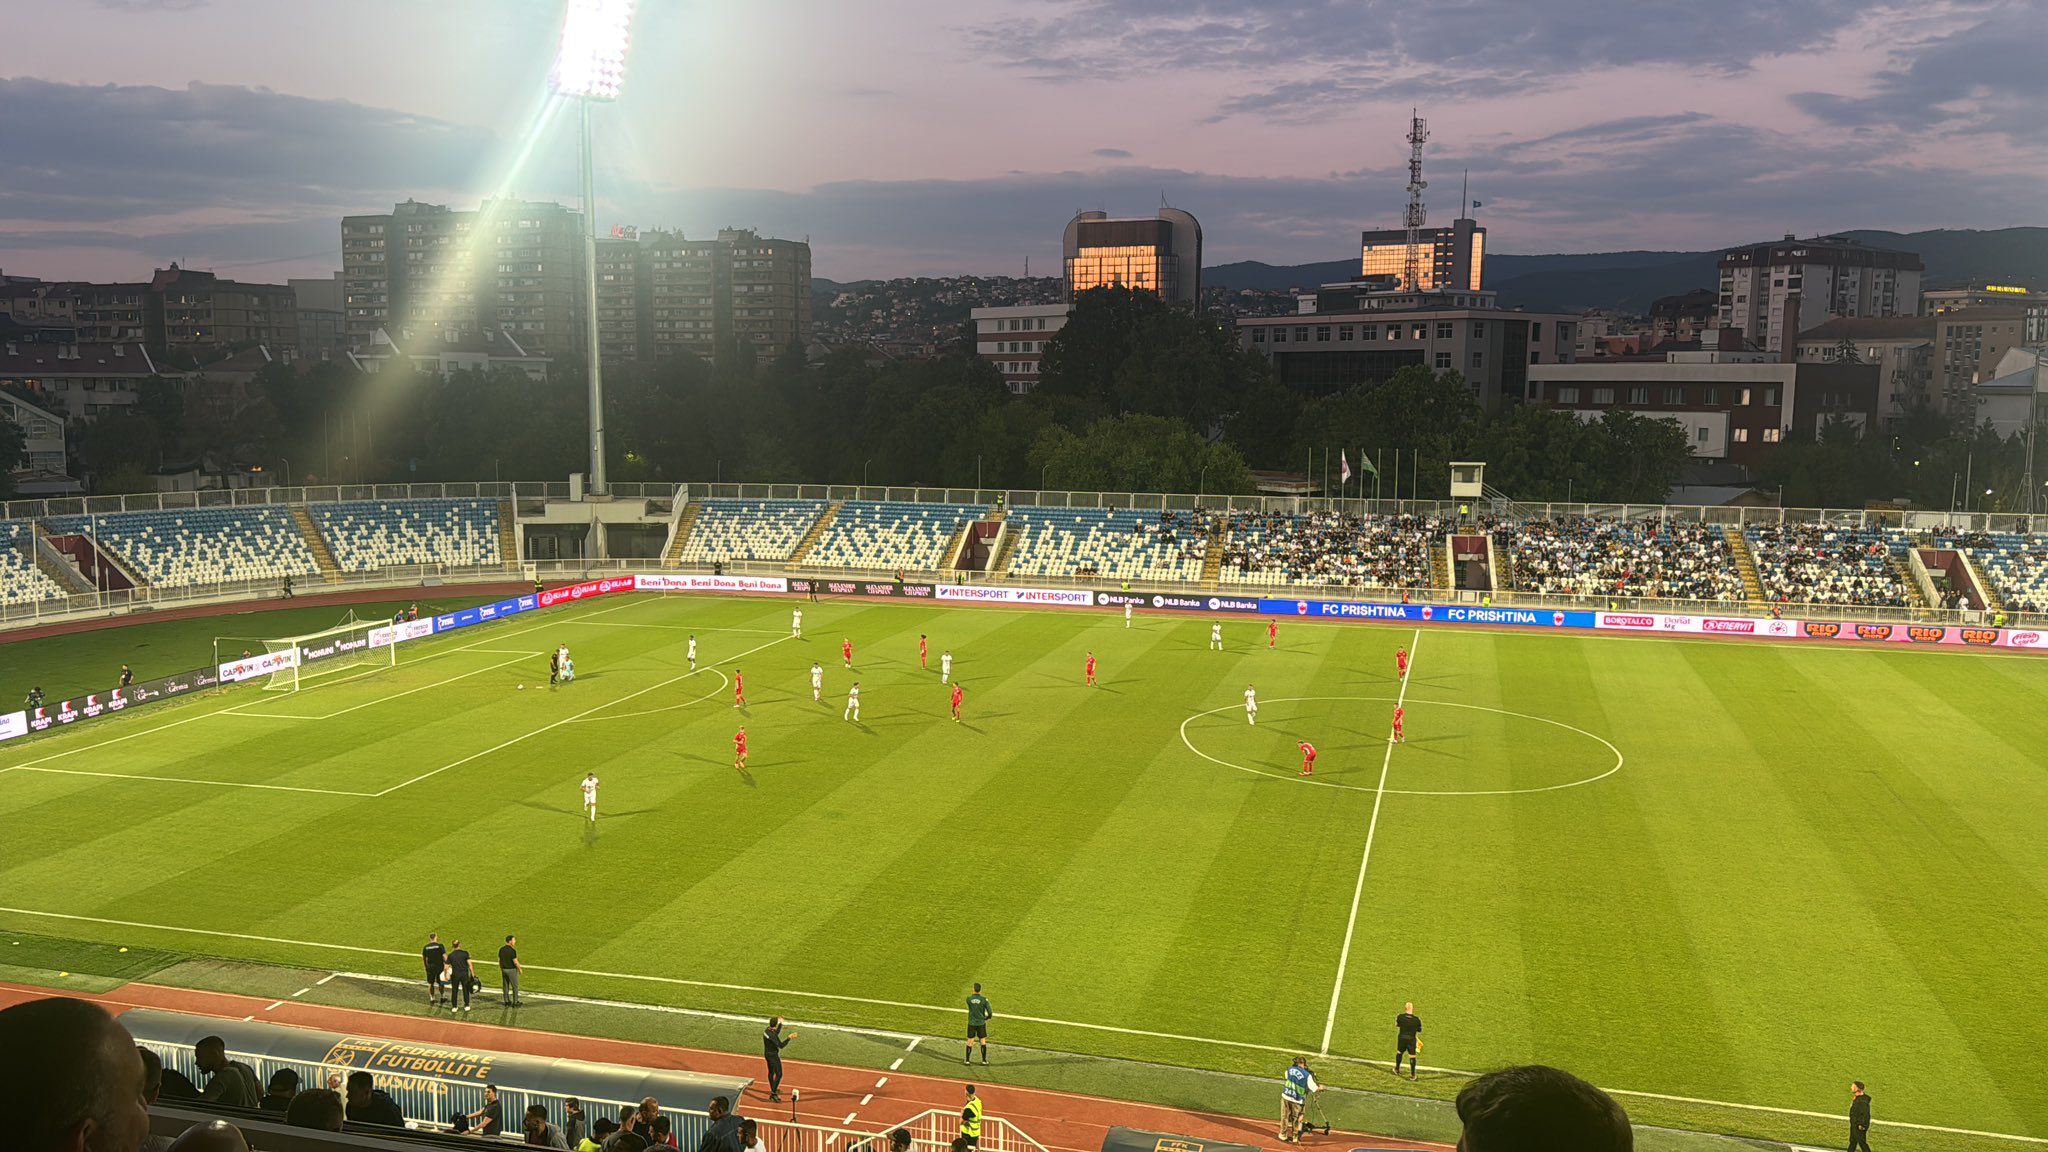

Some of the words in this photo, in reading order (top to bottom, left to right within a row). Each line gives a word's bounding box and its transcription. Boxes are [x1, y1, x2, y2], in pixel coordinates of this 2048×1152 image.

[640, 579, 660, 587] Beni
[664, 579, 687, 587] Dona
[691, 579, 711, 587] Beni
[713, 580, 736, 588] Dona
[738, 580, 758, 588] Beni
[760, 581, 782, 589] Dona
[949, 589, 1008, 599] INTERSPORT
[1025, 592, 1086, 602] INTERSPORT
[1109, 596, 1124, 604] NLB
[1165, 598, 1179, 606] NLB
[1180, 599, 1200, 607] Banka
[1220, 600, 1235, 608] NLB
[1236, 601, 1257, 610] Banka
[1322, 604, 1339, 615] FC
[1341, 605, 1406, 617] PRISHTINA
[1448, 609, 1465, 620] FC
[1468, 610, 1536, 623] PRISHTINA
[1604, 617, 1653, 627] BOROTALCO
[1807, 623, 1838, 634] RIO
[1858, 626, 1890, 636] RIO
[1910, 628, 1942, 638] RIO
[1963, 630, 1996, 641] RIO
[108, 698, 128, 708] KRAPI
[83, 704, 103, 714] KRAPI
[57, 710, 78, 721] KRAPI
[31, 716, 52, 728] KRAPI
[388, 1045, 479, 1063] FEDERATA
[480, 1056, 497, 1065] E
[376, 1054, 477, 1077] FUTBOLLIT
[475, 1066, 492, 1079] E
